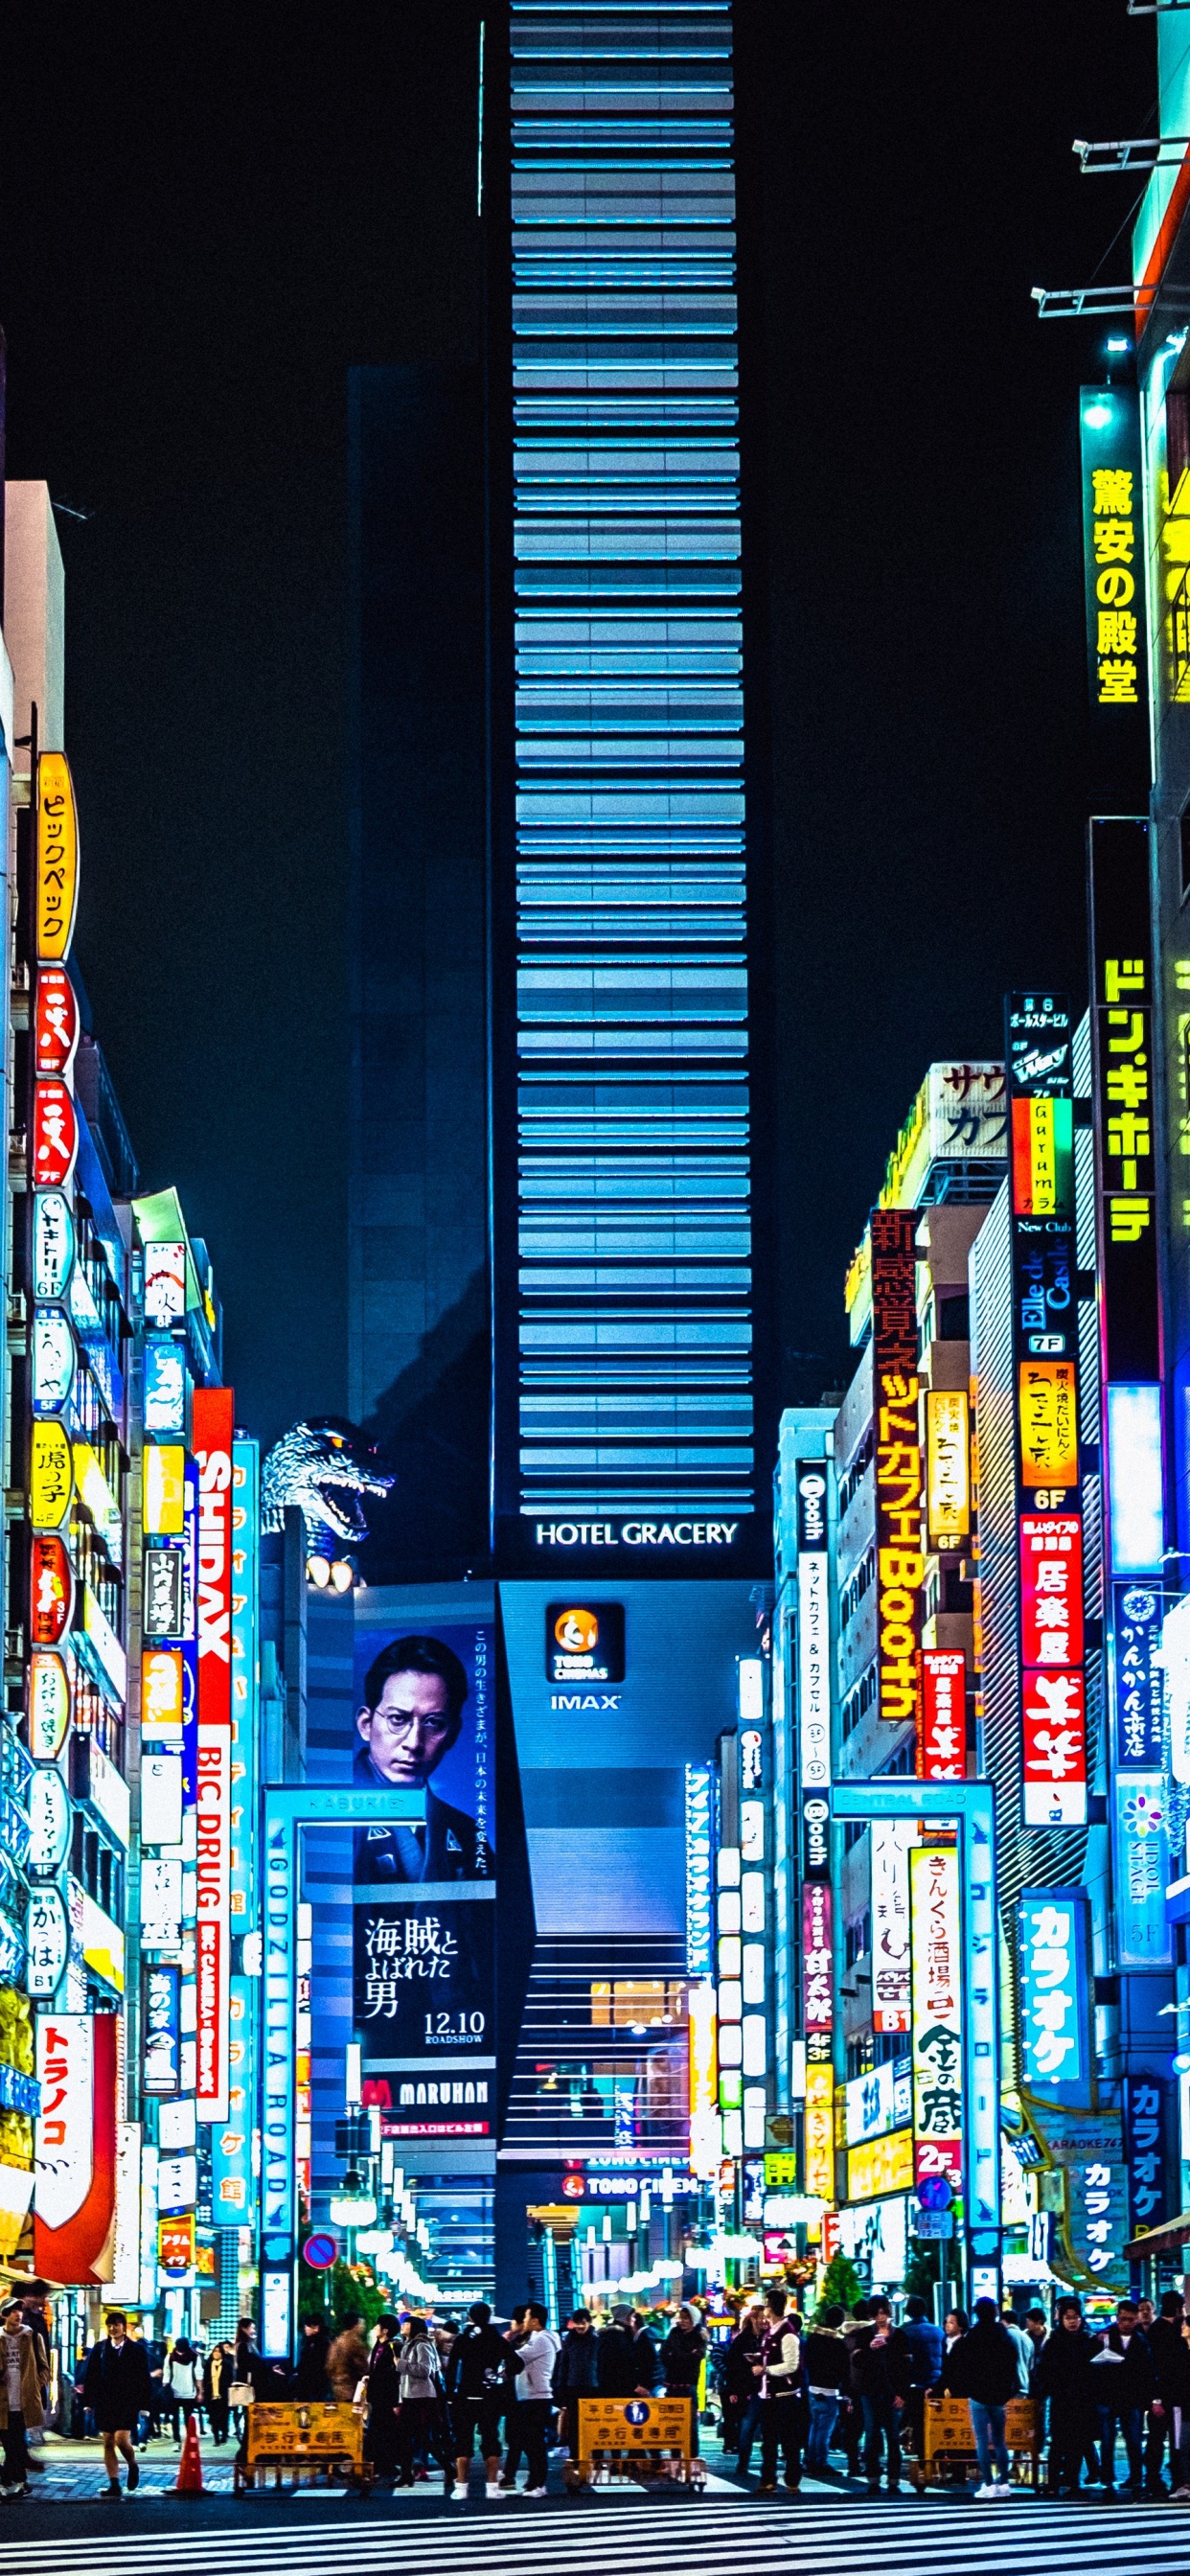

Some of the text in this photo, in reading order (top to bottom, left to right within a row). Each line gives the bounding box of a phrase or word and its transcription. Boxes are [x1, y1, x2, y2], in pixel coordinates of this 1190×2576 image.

[1092, 470, 1137, 702] 驚安の殿堂
[39, 1171, 61, 1182] 7F
[1018, 1222, 1071, 1232] New Club
[37, 1282, 62, 1295] 6F
[1021, 1284, 1045, 1330] Elle
[1033, 1338, 1060, 1350] 7F
[40, 1400, 57, 1410] 5F
[38, 1451, 65, 1503] 虎の子
[1035, 1490, 1065, 1508] 6F
[537, 1524, 739, 1545] HOTEL GRACERY
[938, 1535, 961, 1550] 6F
[195, 1450, 231, 1664] SHIDAX
[1035, 1561, 1071, 1663] 居楽屋
[551, 1695, 620, 1711] IMAX
[1121, 1625, 1147, 1757] かんかん商店
[197, 1746, 221, 1907] BIC DRUG
[34, 1864, 54, 1875] 1F
[927, 1856, 951, 1988] きんくら酒場
[1132, 1924, 1158, 1943] 5F
[365, 1918, 458, 1957] 海賊と
[365, 1957, 451, 1981] よばれた
[804, 1947, 833, 2023] 甘太郎
[1031, 1906, 1074, 2074] カラオケ
[363, 1982, 399, 2019] 男
[267, 1858, 288, 2193] GODZILLA ROAD
[424, 2012, 485, 2035] 12.10
[425, 2035, 483, 2044] ROADSHOW
[808, 2033, 832, 2046] 4F
[808, 2046, 831, 2060] 3F
[43, 2028, 69, 2146] トラノコ
[917, 2023, 962, 2135] 金の蔵
[400, 2082, 488, 2104] MARUHAN
[918, 2144, 953, 2174] 2F
[1133, 2084, 1163, 2219] カラオケ
[1084, 2163, 1115, 2272] カラオケ
[598, 2427, 680, 2440] 歩行者専用
